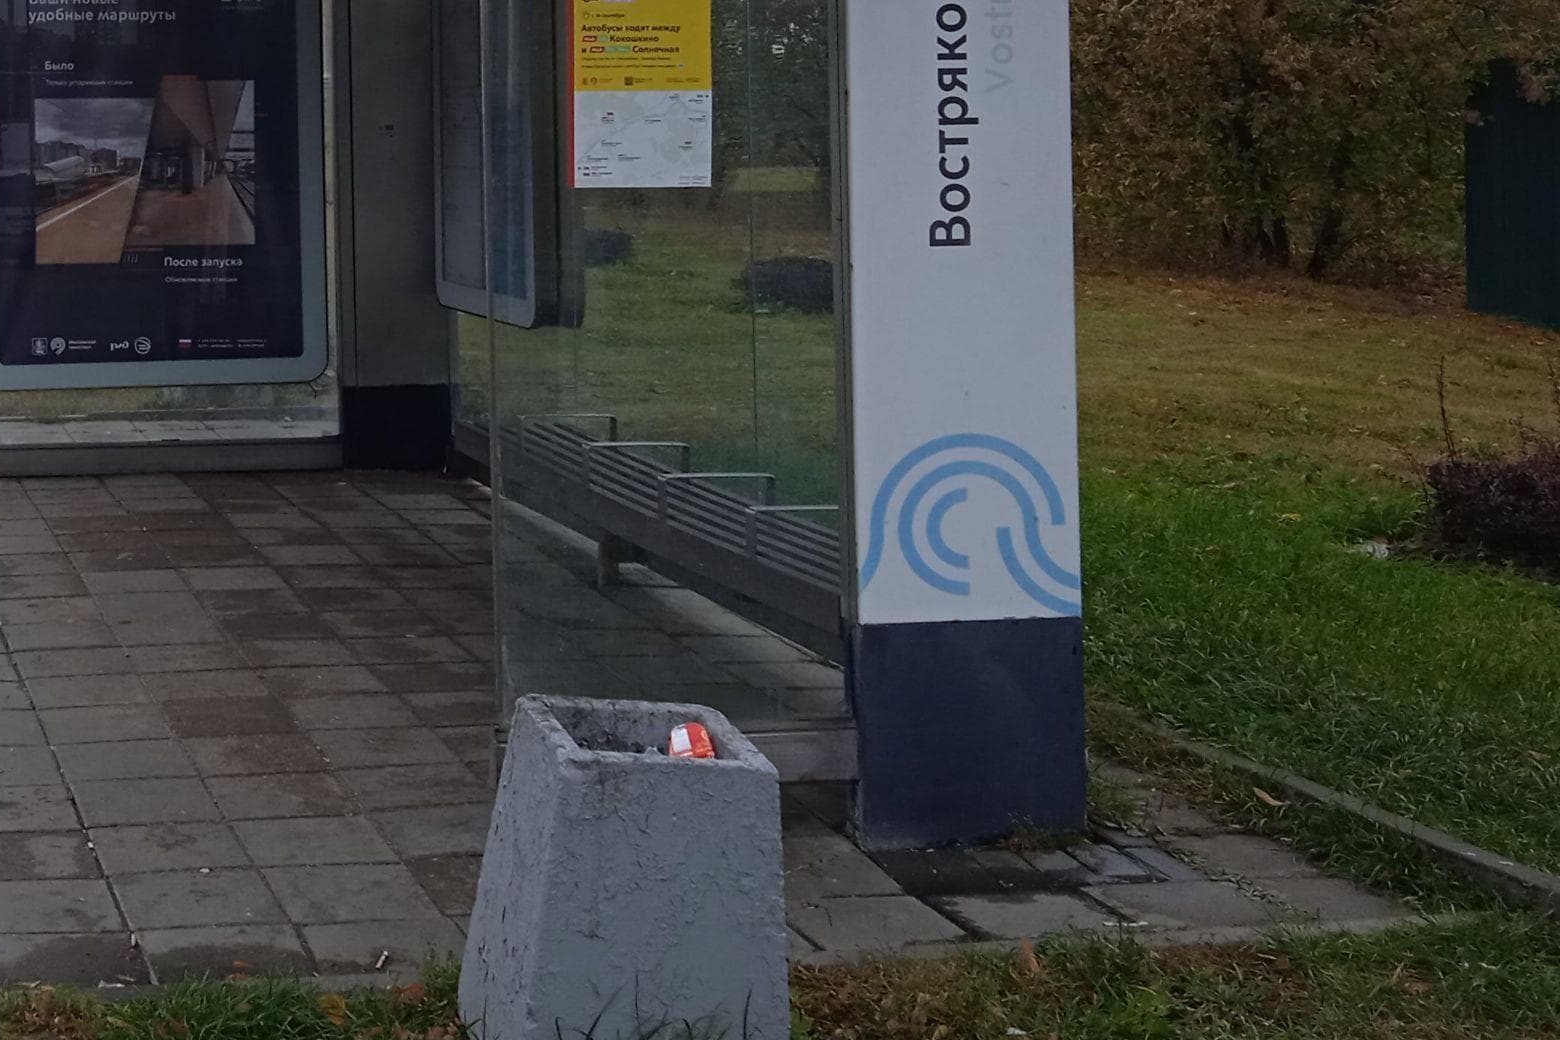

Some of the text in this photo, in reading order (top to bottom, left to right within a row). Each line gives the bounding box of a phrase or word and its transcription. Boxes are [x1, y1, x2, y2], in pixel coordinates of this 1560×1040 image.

[28, 8, 176, 24] удобные маршруты
[581, 24, 623, 33] Автобусы
[609, 35, 660, 43] Кокошкино
[632, 45, 680, 53] Солнечная
[44, 60, 75, 71] Было
[164, 256, 243, 268] После запуска
